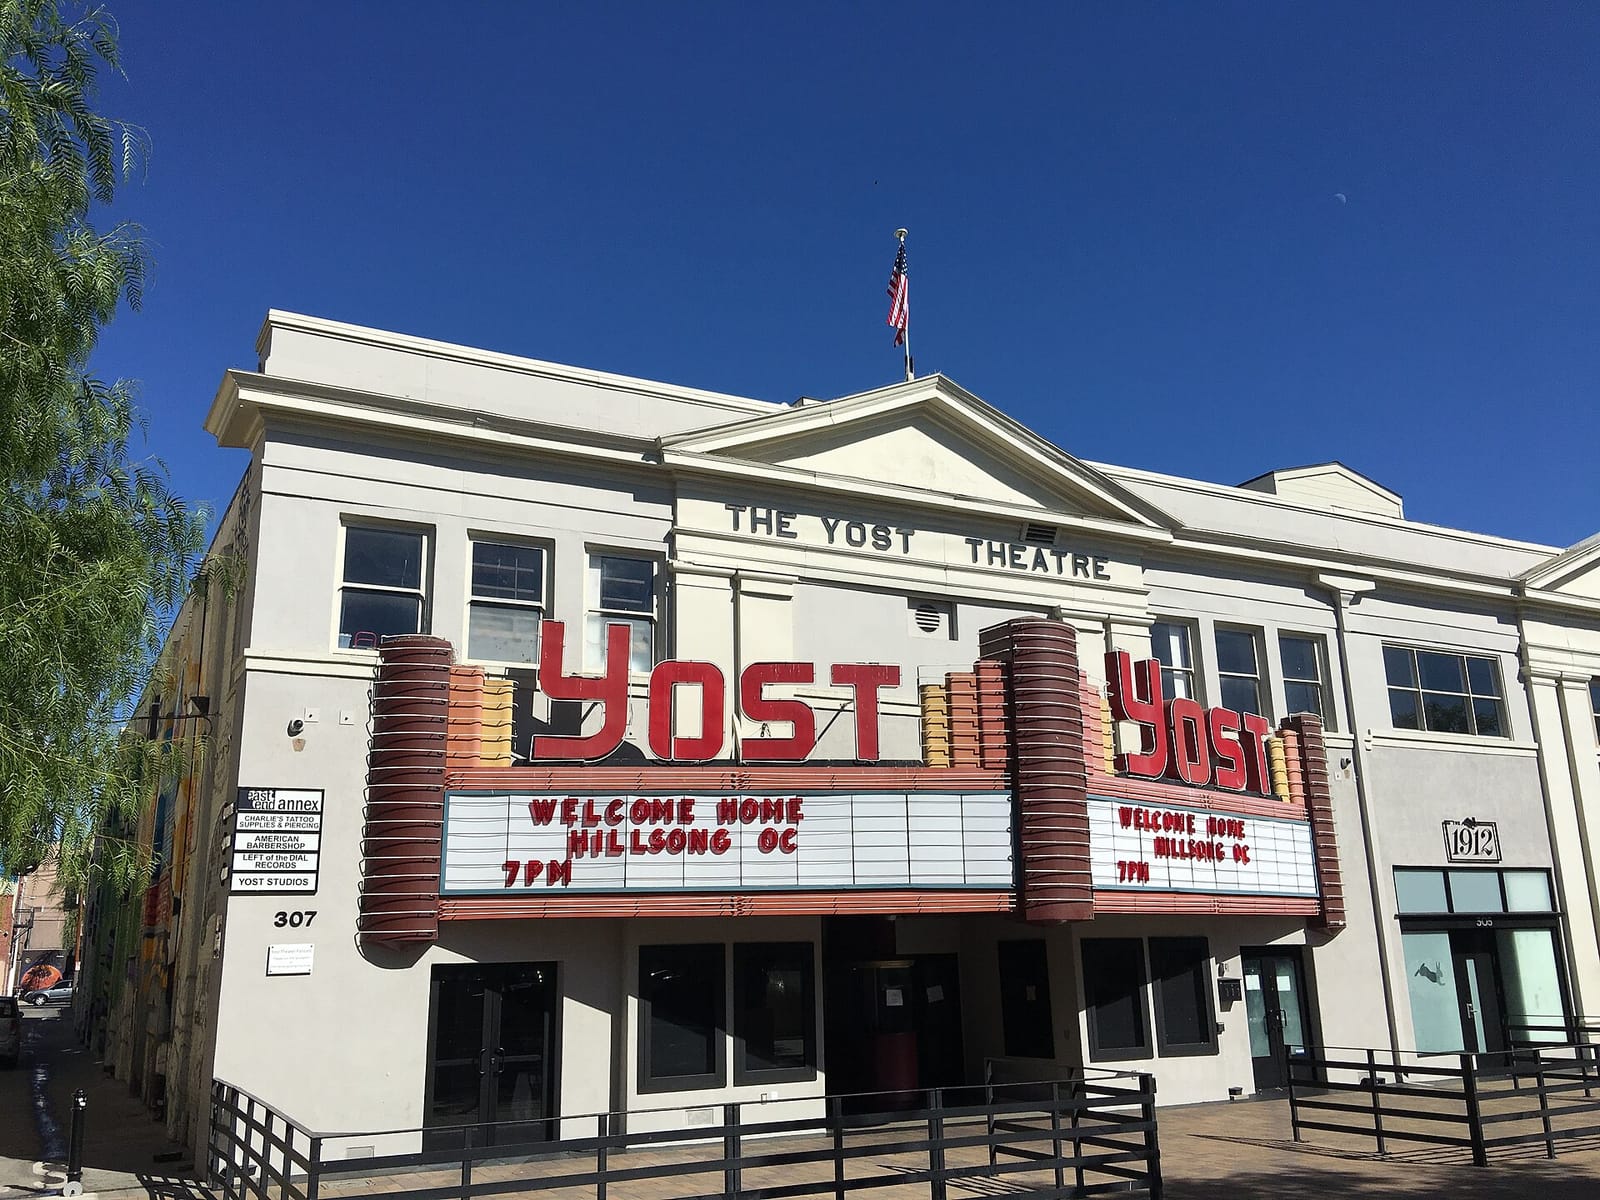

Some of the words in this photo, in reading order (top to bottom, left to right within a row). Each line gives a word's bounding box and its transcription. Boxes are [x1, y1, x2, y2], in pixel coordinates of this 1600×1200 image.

[724, 503, 798, 538] THE
[821, 517, 915, 554] YOST
[964, 537, 1111, 581] THEATRE
[530, 619, 902, 764] YOST
[1104, 650, 1272, 796] YOST
[247, 790, 275, 801] east
[254, 799, 275, 810] end
[277, 799, 319, 811] annex
[528, 798, 695, 827] WELCOME
[716, 798, 805, 826] HOME
[1118, 806, 1196, 835] WELCOME
[1206, 816, 1246, 840] HOME
[246, 842, 306, 850] BARBERSHOP
[254, 835, 300, 843] AMERICAN
[566, 828, 731, 859] HILLSONG
[757, 827, 798, 855] OC
[1153, 836, 1226, 864] HILLSONG
[1232, 843, 1251, 865] OC
[1452, 828, 1494, 856] 1912
[254, 861, 297, 869] RECORDS
[289, 854, 309, 862] DIAL
[238, 877, 264, 886] YOST
[266, 878, 309, 886] STUDIOS
[502, 860, 573, 888] 7PM
[1117, 860, 1150, 883] 7PM
[273, 910, 318, 928] 307
